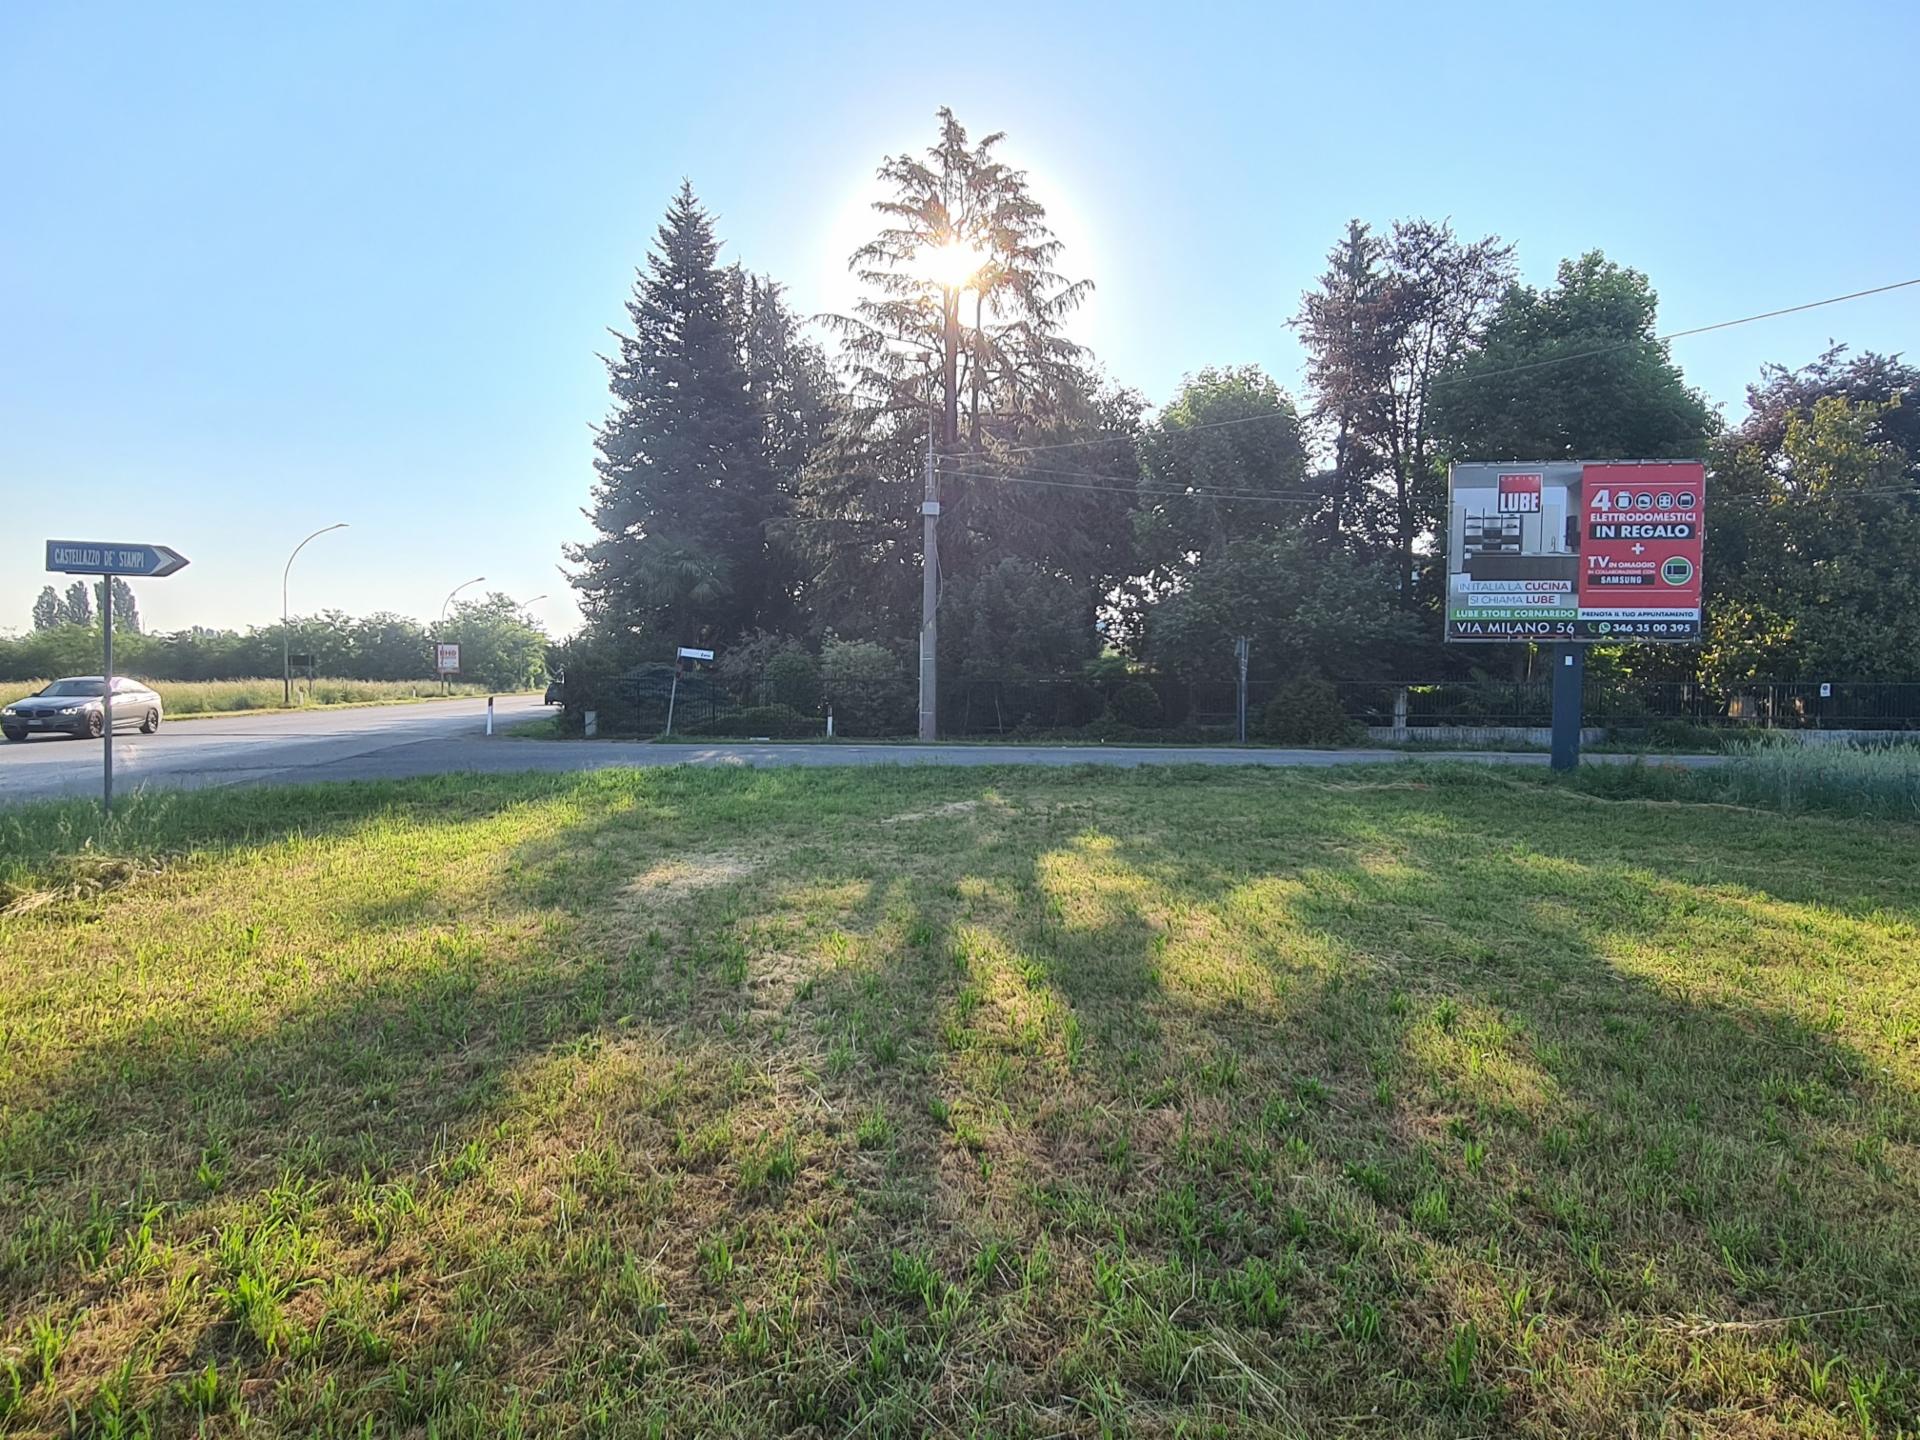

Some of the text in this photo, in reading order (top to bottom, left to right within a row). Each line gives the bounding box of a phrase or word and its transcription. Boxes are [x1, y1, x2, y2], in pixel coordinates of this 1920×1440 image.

[1500, 493, 1539, 512] LUBE
[1591, 489, 1611, 511] 4
[1591, 513, 1696, 522] ELETTRODOMESTICI
[1596, 525, 1689, 537] IN REGALO
[55, 548, 100, 566] CASTELLAZZO
[119, 551, 144, 568] STAMPI
[1588, 556, 1610, 568] TV
[1601, 576, 1642, 584] SAMSUNG
[1470, 596, 1555, 604] SI CHIAMA LUBE
[1457, 622, 1575, 633] VIA MILANO 56
[1612, 624, 1690, 632] 346 35 00 395
